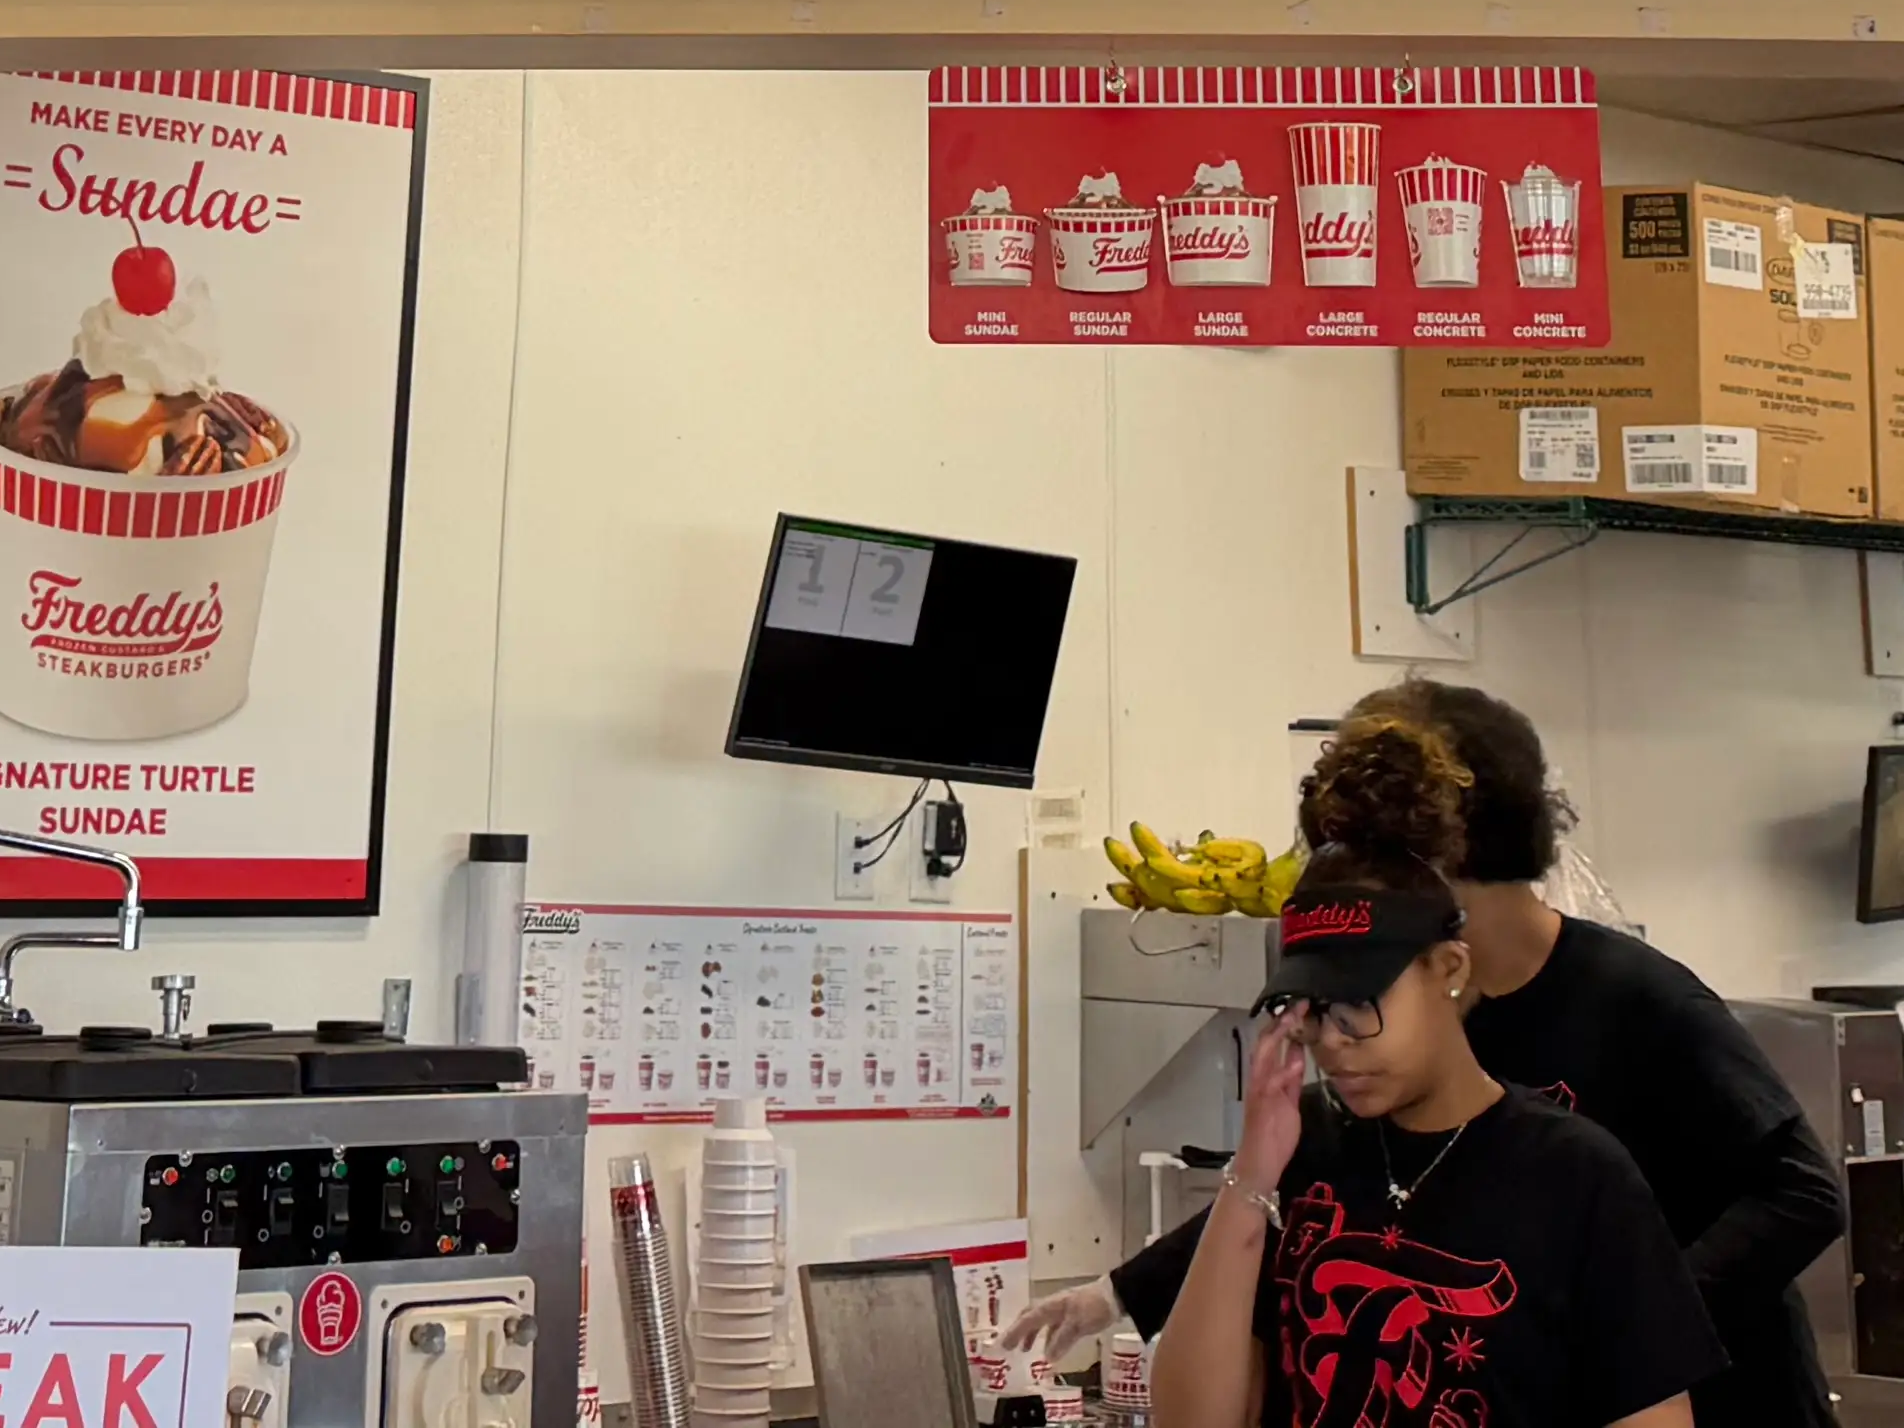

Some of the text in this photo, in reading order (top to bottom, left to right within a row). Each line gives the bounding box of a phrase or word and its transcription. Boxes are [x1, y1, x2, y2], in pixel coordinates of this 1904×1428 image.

[31, 102, 288, 156] MAKE EVERY DAY A
[38, 144, 270, 235] Sundae
[1630, 221, 1655, 238] 500
[978, 312, 1005, 322] MINI
[1070, 312, 1131, 322] REGULAR
[1199, 312, 1242, 323] LARGE
[1320, 312, 1363, 323] LARGE
[1418, 313, 1480, 323] REGULAR
[1534, 313, 1563, 324] MINI
[965, 325, 1018, 335] SUNDAE
[1075, 323, 1126, 335] SUNDAE
[1195, 326, 1247, 336] SUNDAE
[1307, 326, 1377, 336] CONCRETE
[1414, 323, 1488, 337] CONCRETE
[1514, 326, 1585, 337] CONCRETE
[871, 555, 904, 603] 2
[22, 571, 222, 659] Freddy's
[140, 765, 254, 792] TURTLE
[39, 807, 166, 834] SUNDAE
[523, 908, 581, 929] Freddy's
